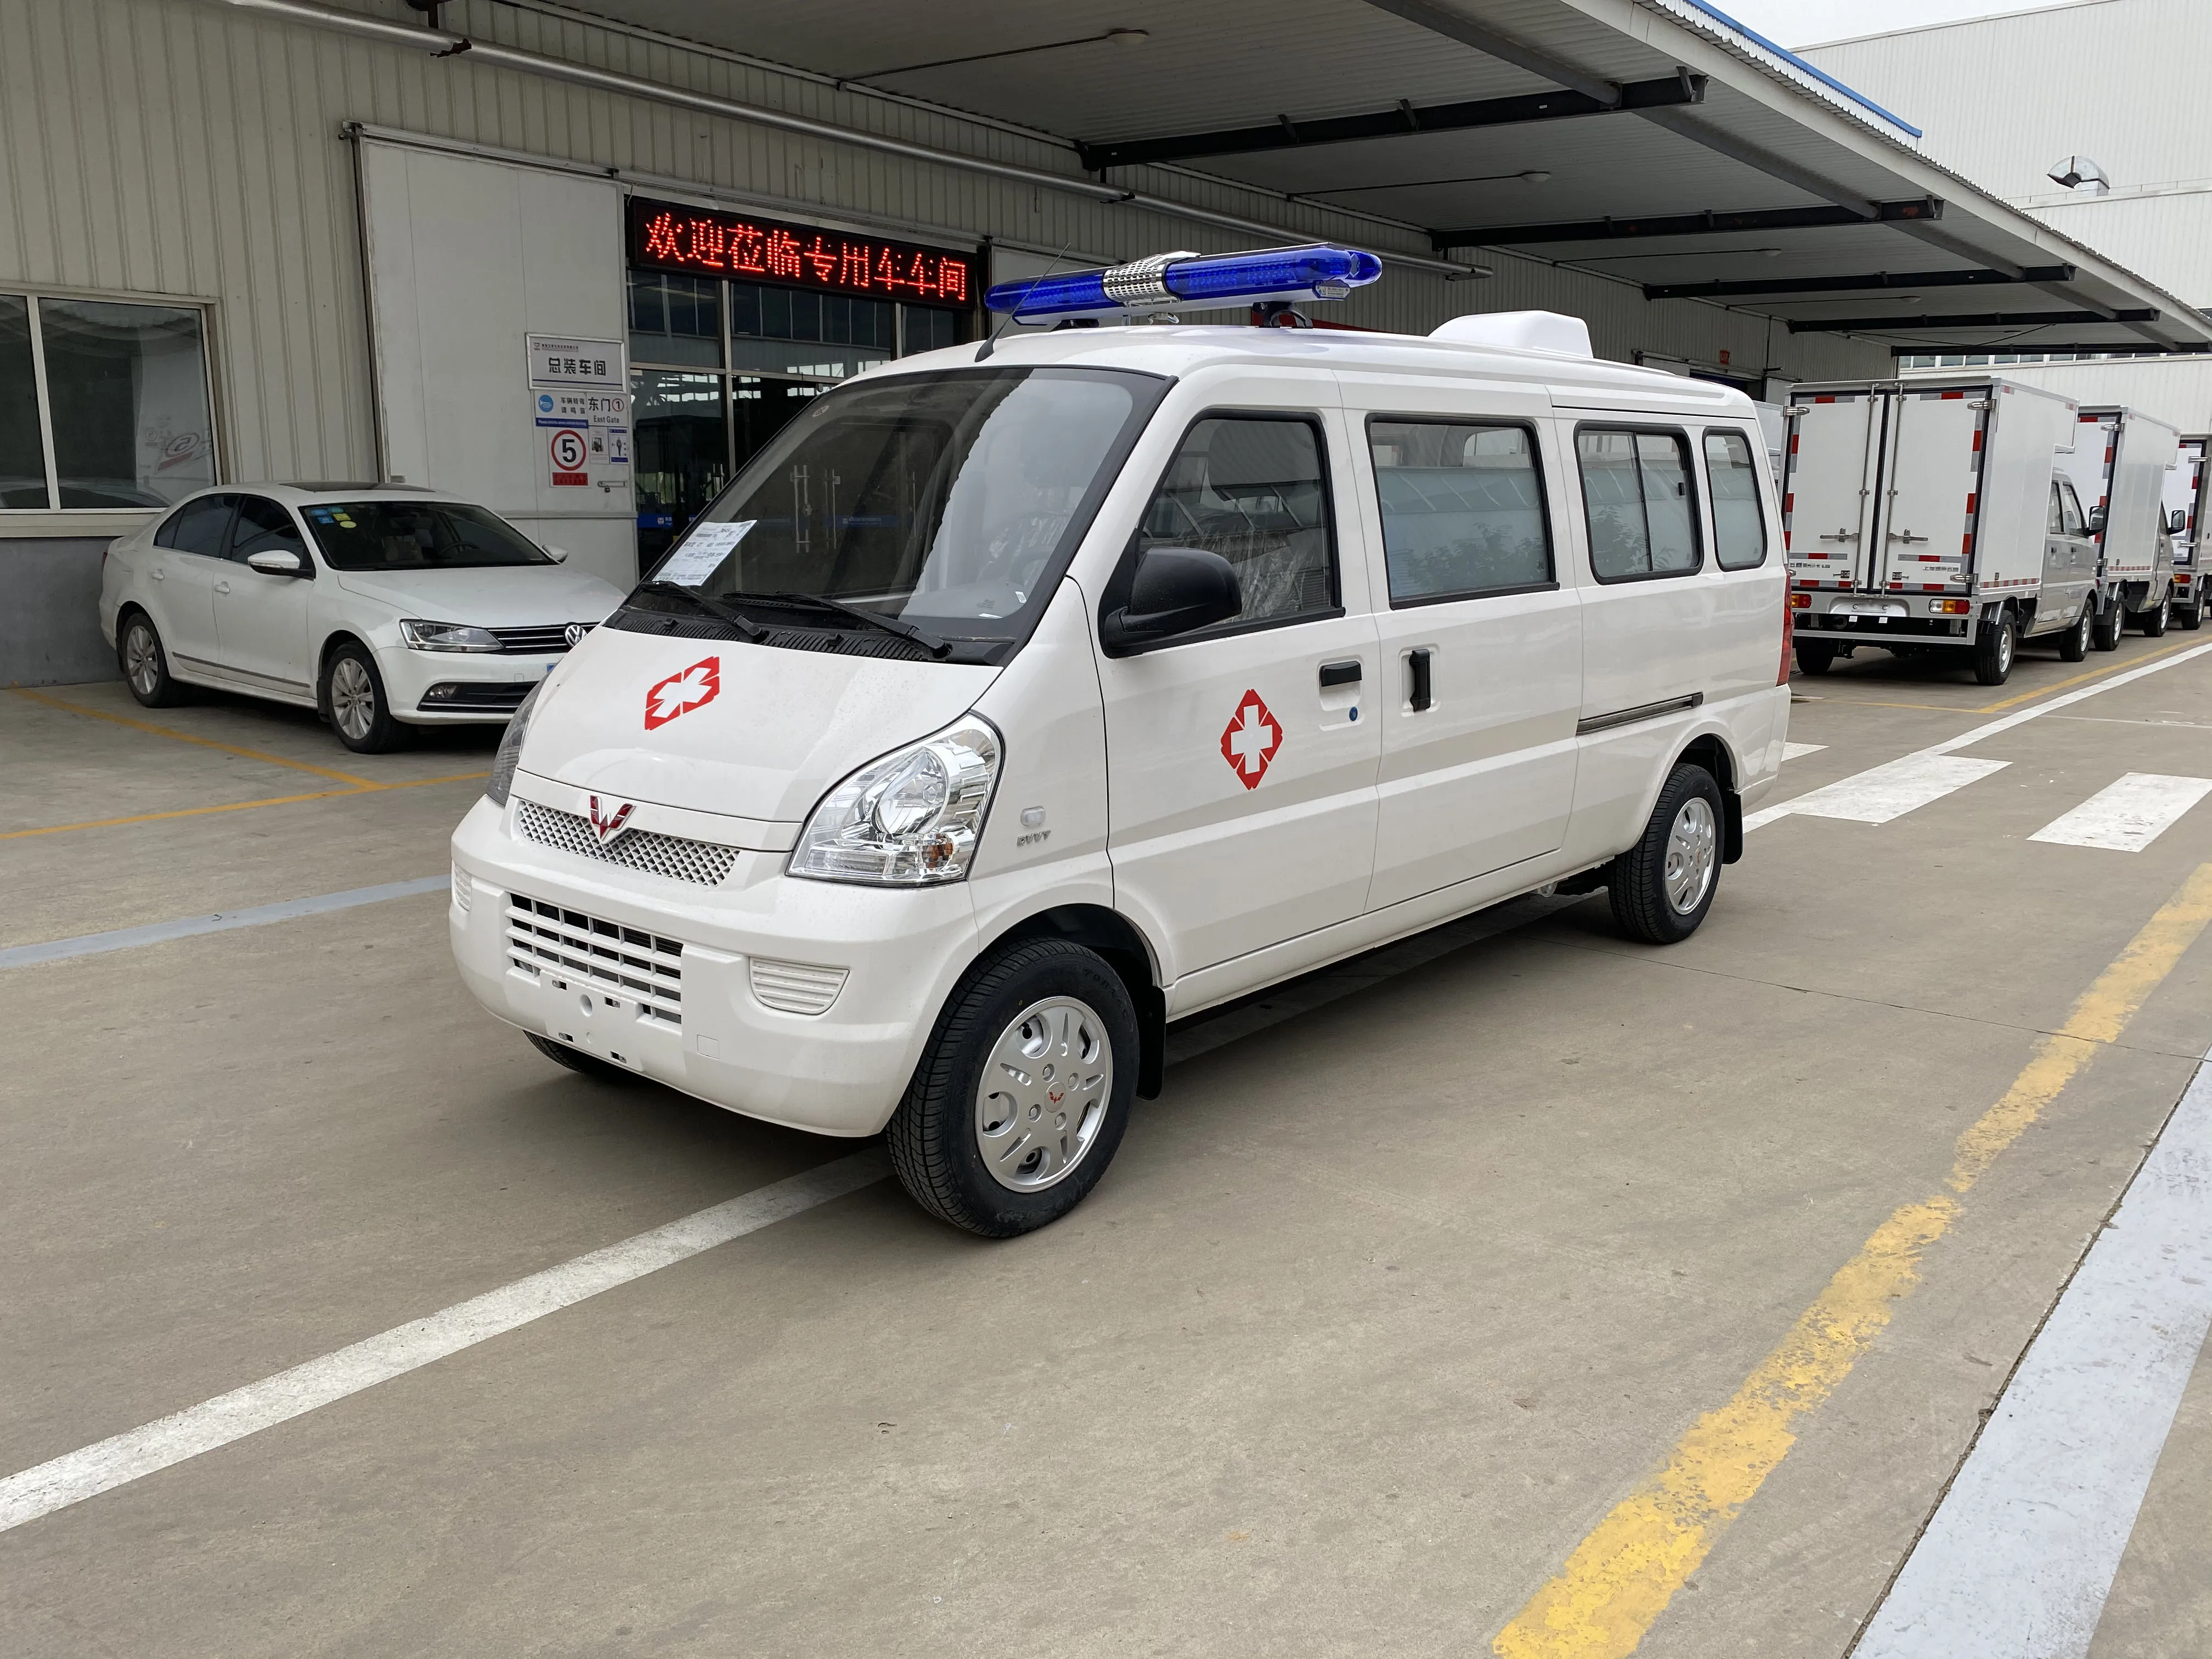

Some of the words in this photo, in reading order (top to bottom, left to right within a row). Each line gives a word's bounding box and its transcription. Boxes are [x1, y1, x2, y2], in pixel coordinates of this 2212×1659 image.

[645, 211, 967, 302] 欢迎莅临专用车车间
[548, 357, 606, 376] 总装车间
[593, 415, 605, 423] East
[562, 438, 577, 463] 5
[1017, 830, 1051, 847] DVVT
